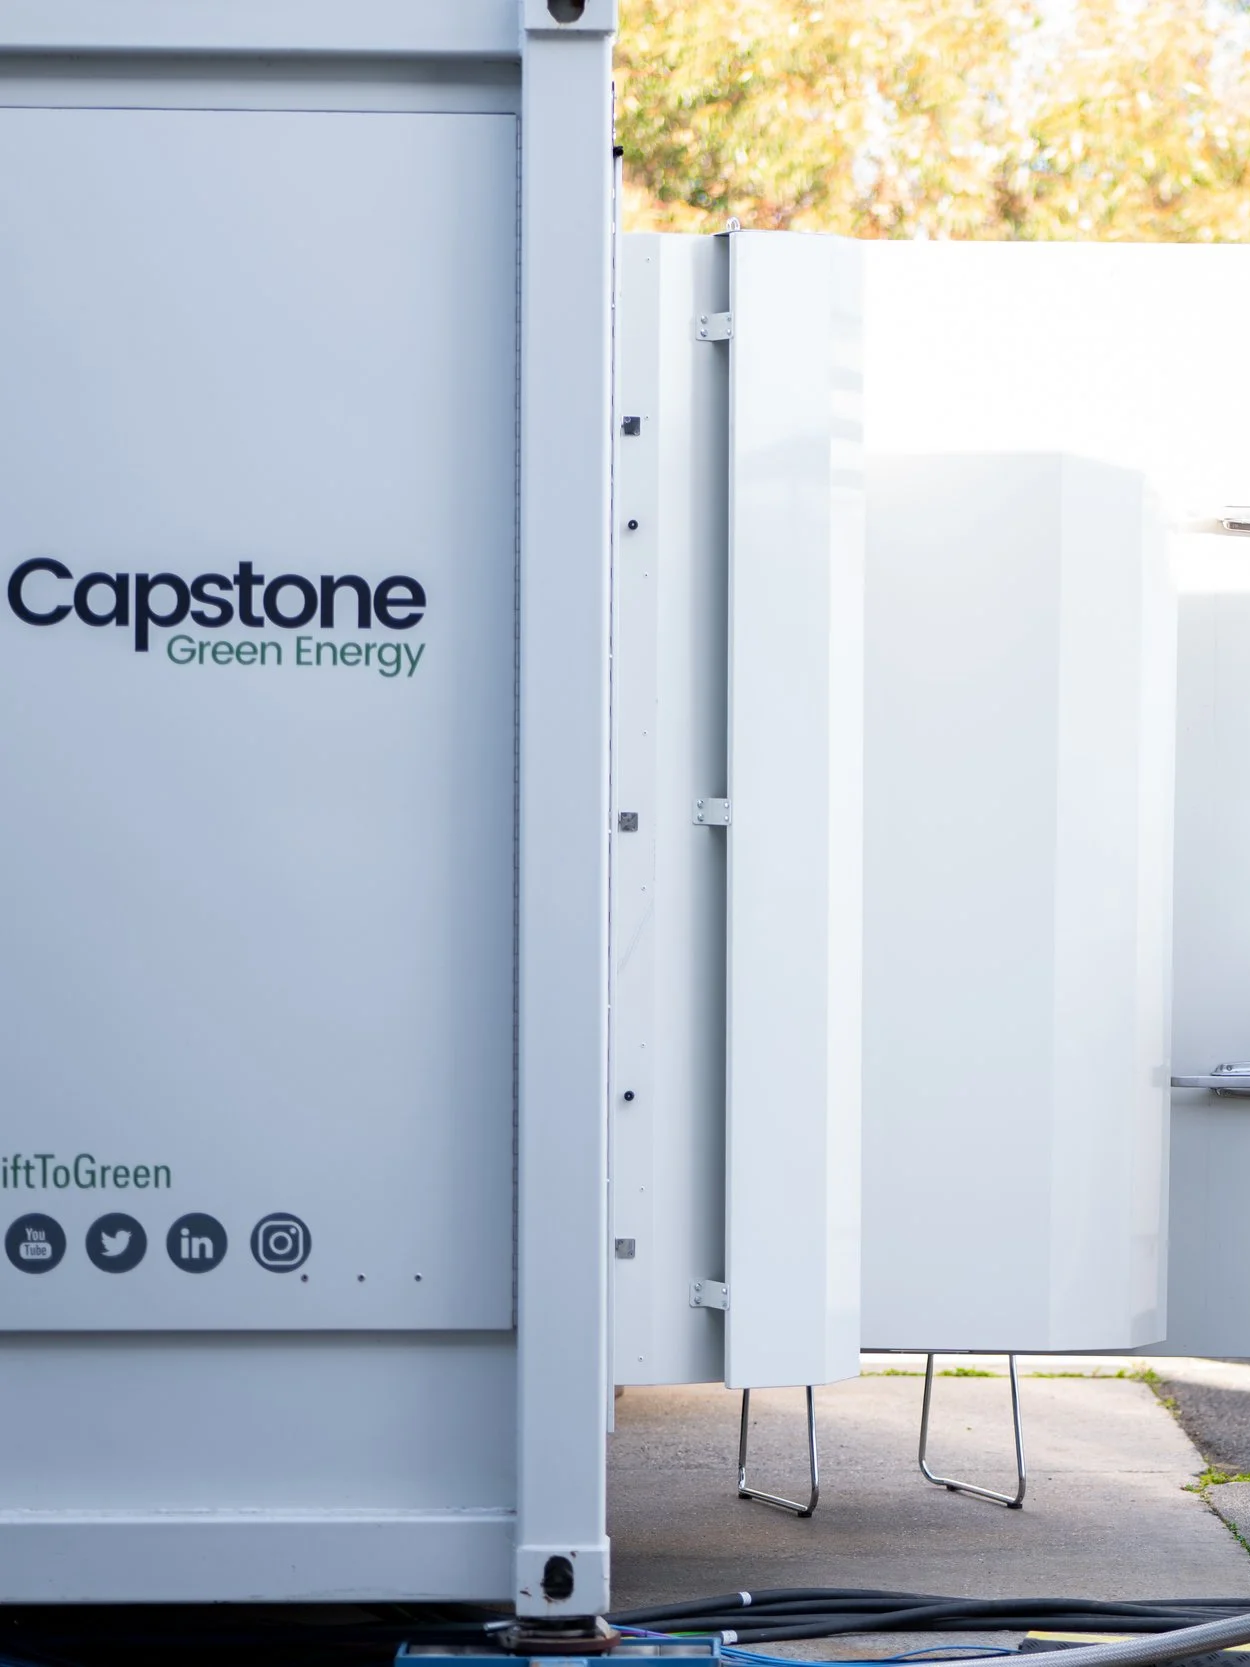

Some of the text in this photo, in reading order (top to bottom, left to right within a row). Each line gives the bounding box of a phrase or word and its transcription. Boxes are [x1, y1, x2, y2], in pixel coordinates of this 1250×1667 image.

[8, 557, 427, 652] Capstone
[167, 635, 426, 677] Green Energy
[25, 1228, 46, 1241] You
[25, 1244, 47, 1257] Tube
